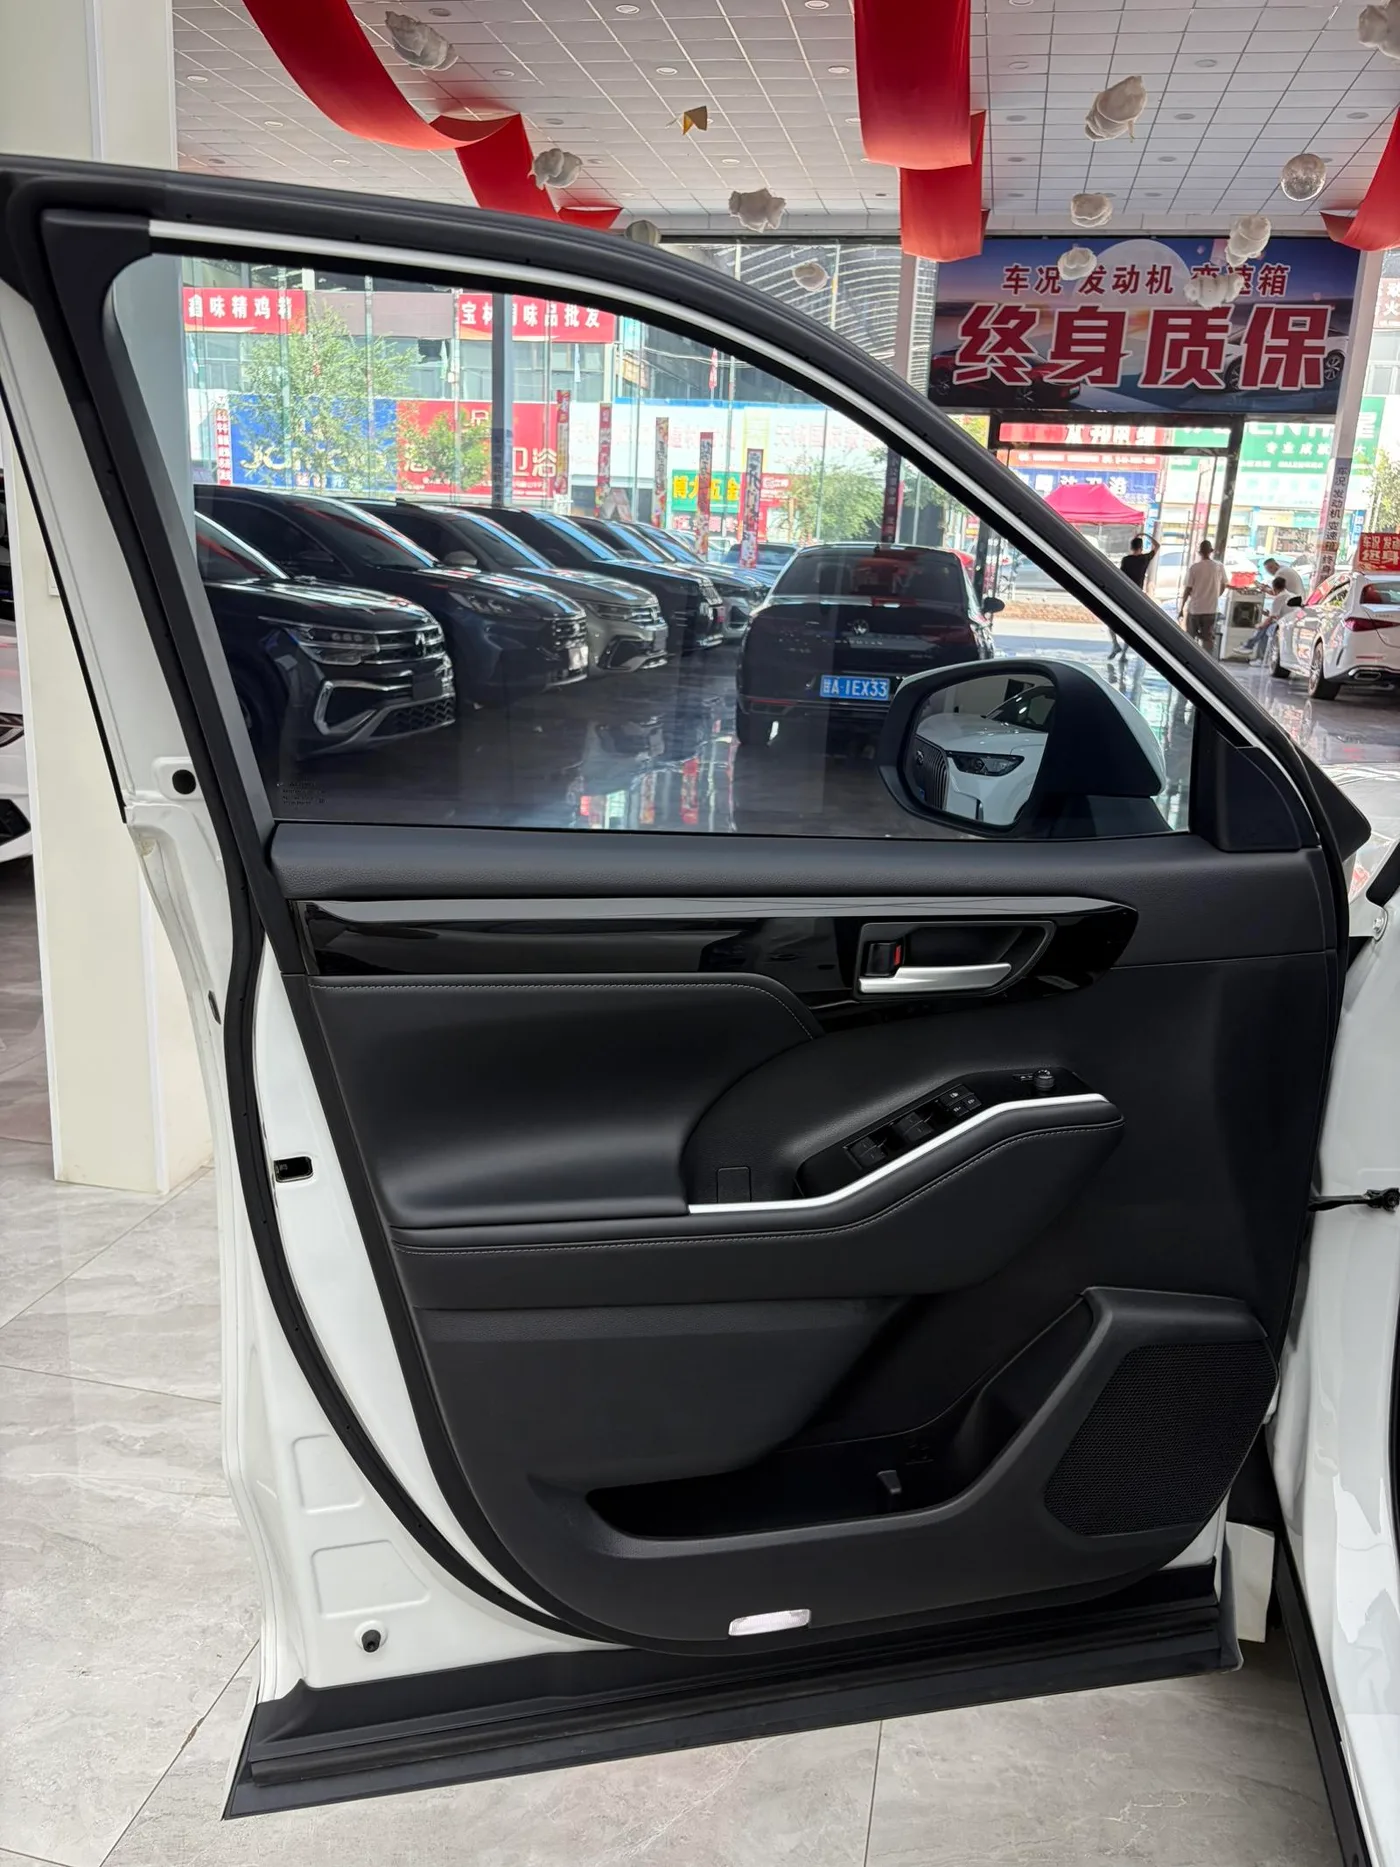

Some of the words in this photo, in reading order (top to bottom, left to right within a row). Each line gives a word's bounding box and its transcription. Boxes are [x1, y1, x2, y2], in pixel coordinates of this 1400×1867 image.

[1002, 264, 1062, 296] 车况
[1078, 264, 1174, 296] 发动机
[954, 303, 1331, 390] 终身质保
